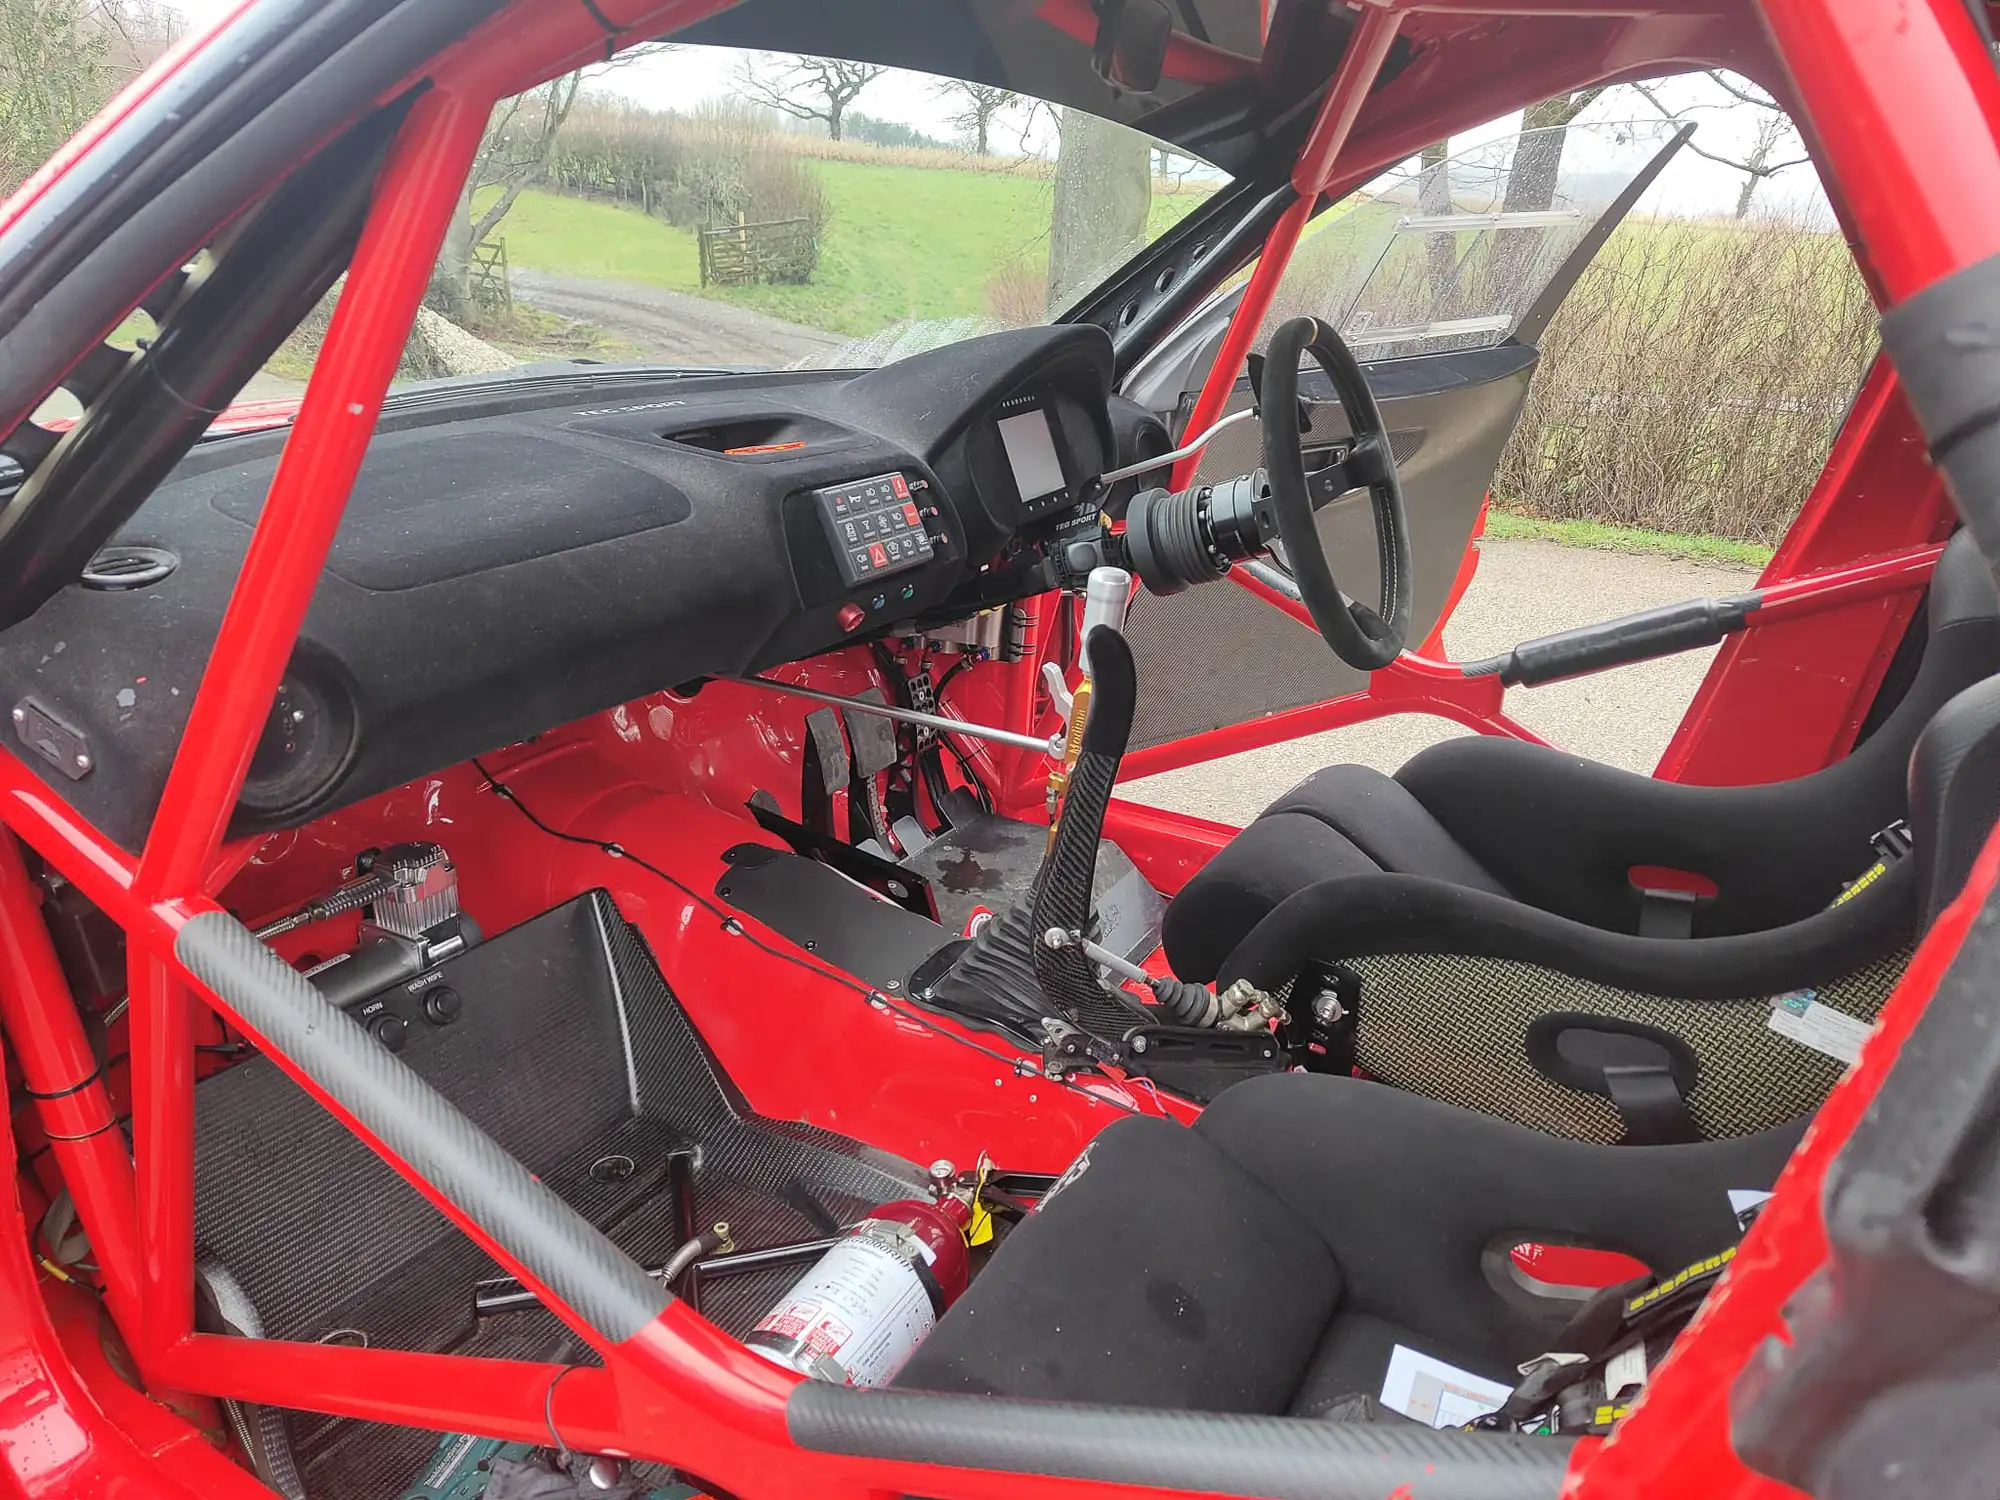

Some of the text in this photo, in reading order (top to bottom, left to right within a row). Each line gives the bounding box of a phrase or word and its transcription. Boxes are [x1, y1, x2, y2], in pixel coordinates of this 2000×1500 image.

[1071, 513, 1097, 527] SPORT
[407, 970, 444, 993] WASH WIPE
[363, 1001, 384, 1015] HORN
